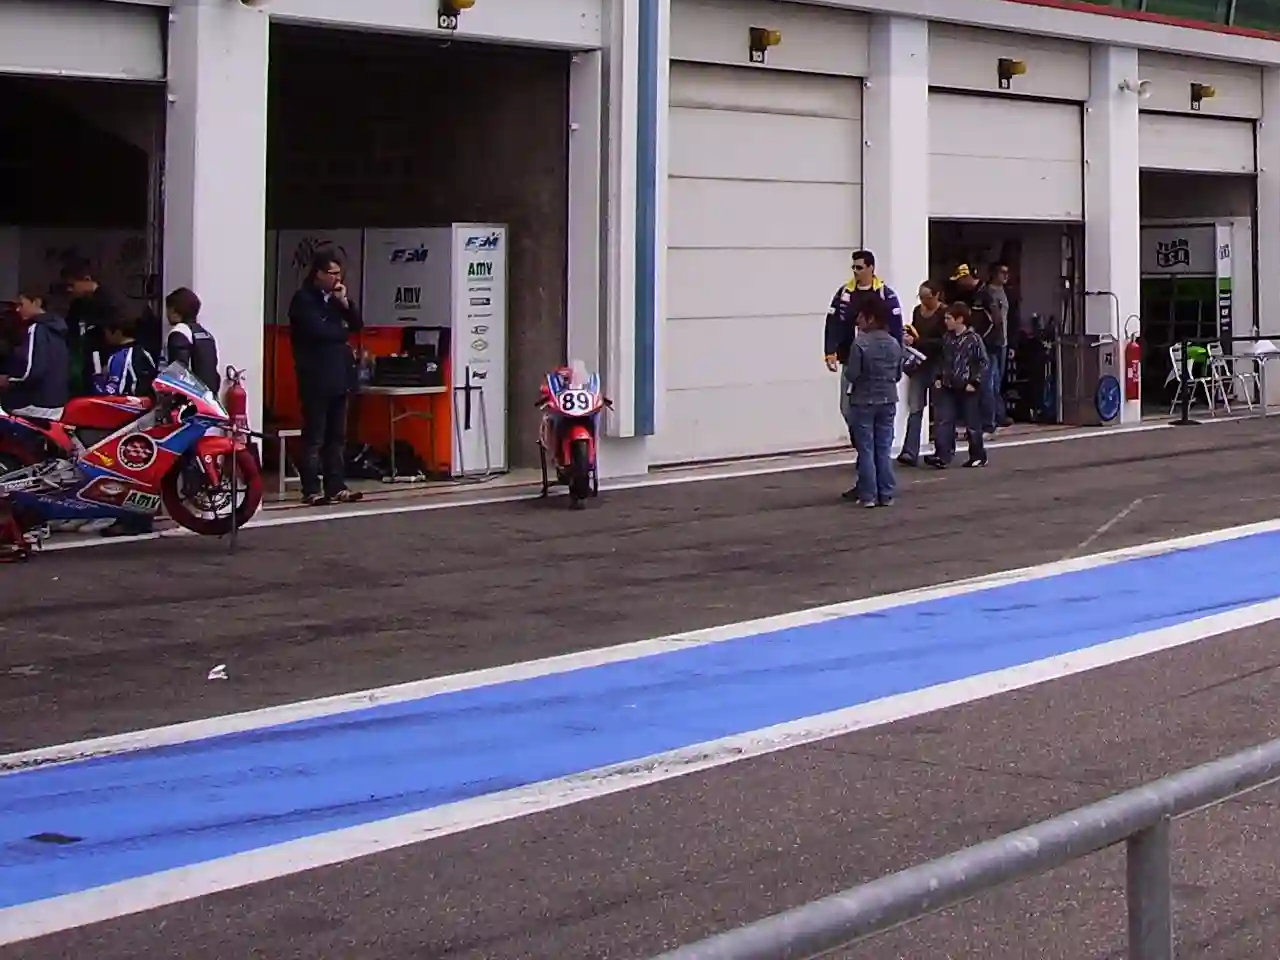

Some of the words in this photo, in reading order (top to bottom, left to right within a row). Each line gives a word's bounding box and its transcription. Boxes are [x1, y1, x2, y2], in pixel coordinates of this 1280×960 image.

[468, 261, 493, 276] AMV
[562, 393, 589, 410] 89
[126, 493, 160, 509] AMV
